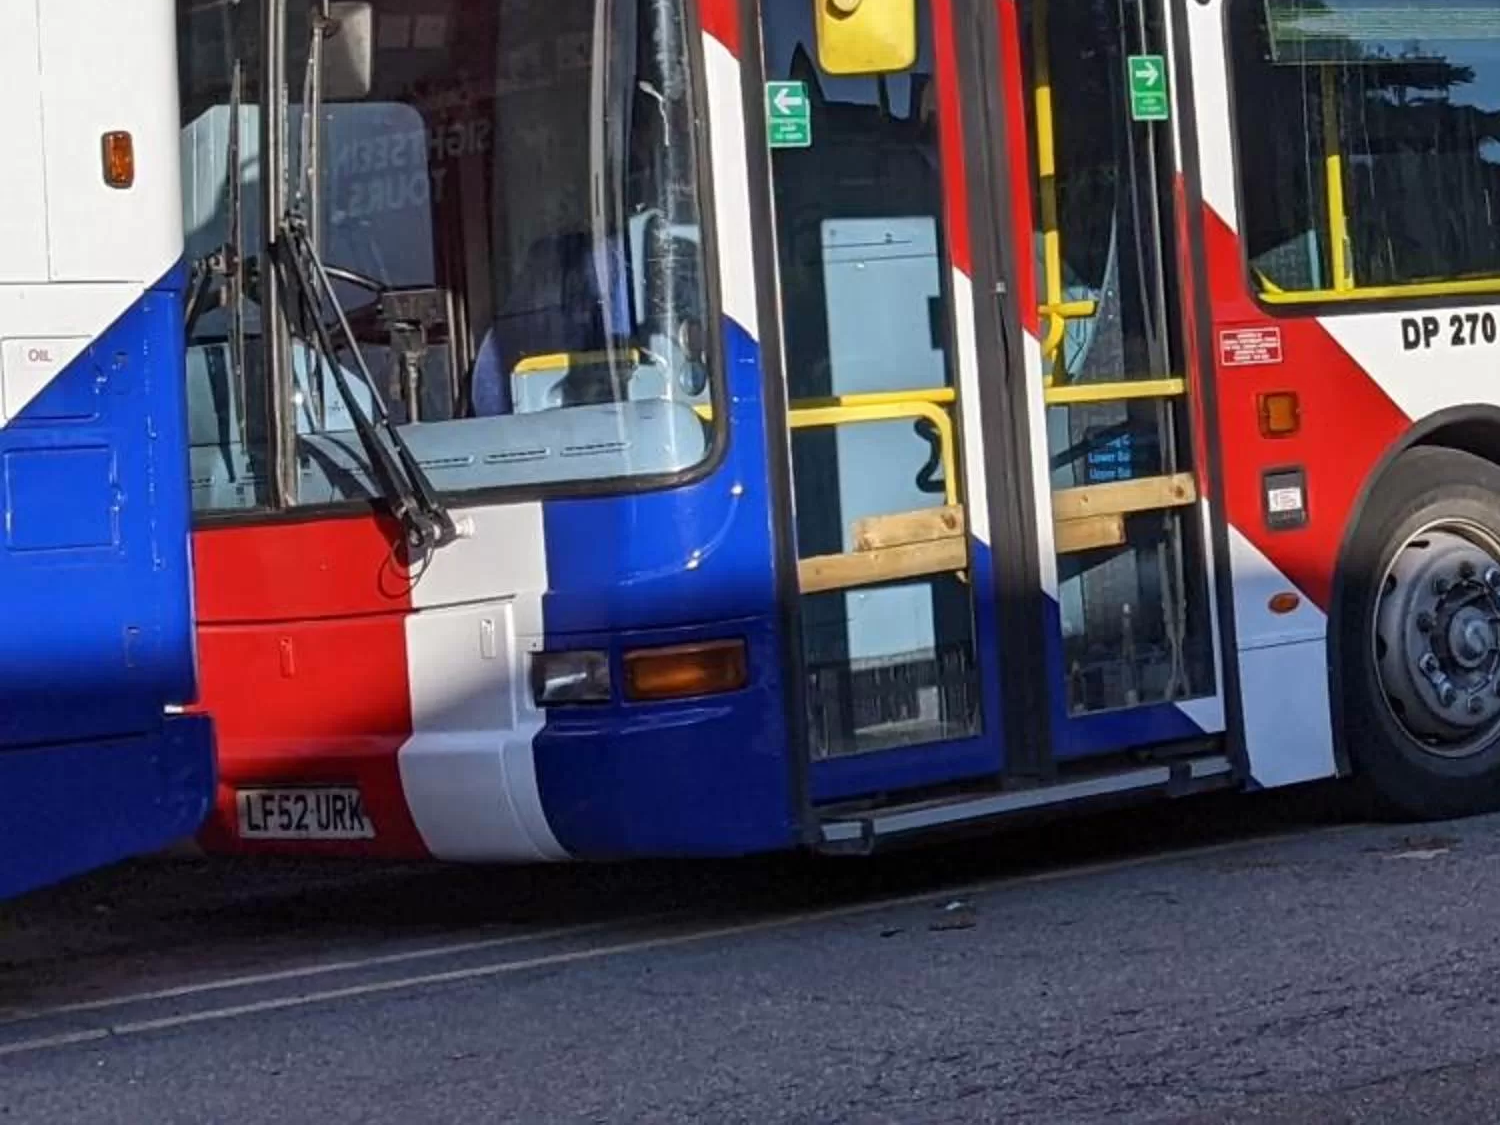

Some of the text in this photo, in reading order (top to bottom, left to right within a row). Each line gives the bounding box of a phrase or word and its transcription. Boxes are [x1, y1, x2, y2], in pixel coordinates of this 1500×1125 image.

[1401, 312, 1497, 350] DP 270
[246, 794, 365, 831] LF52 URK
